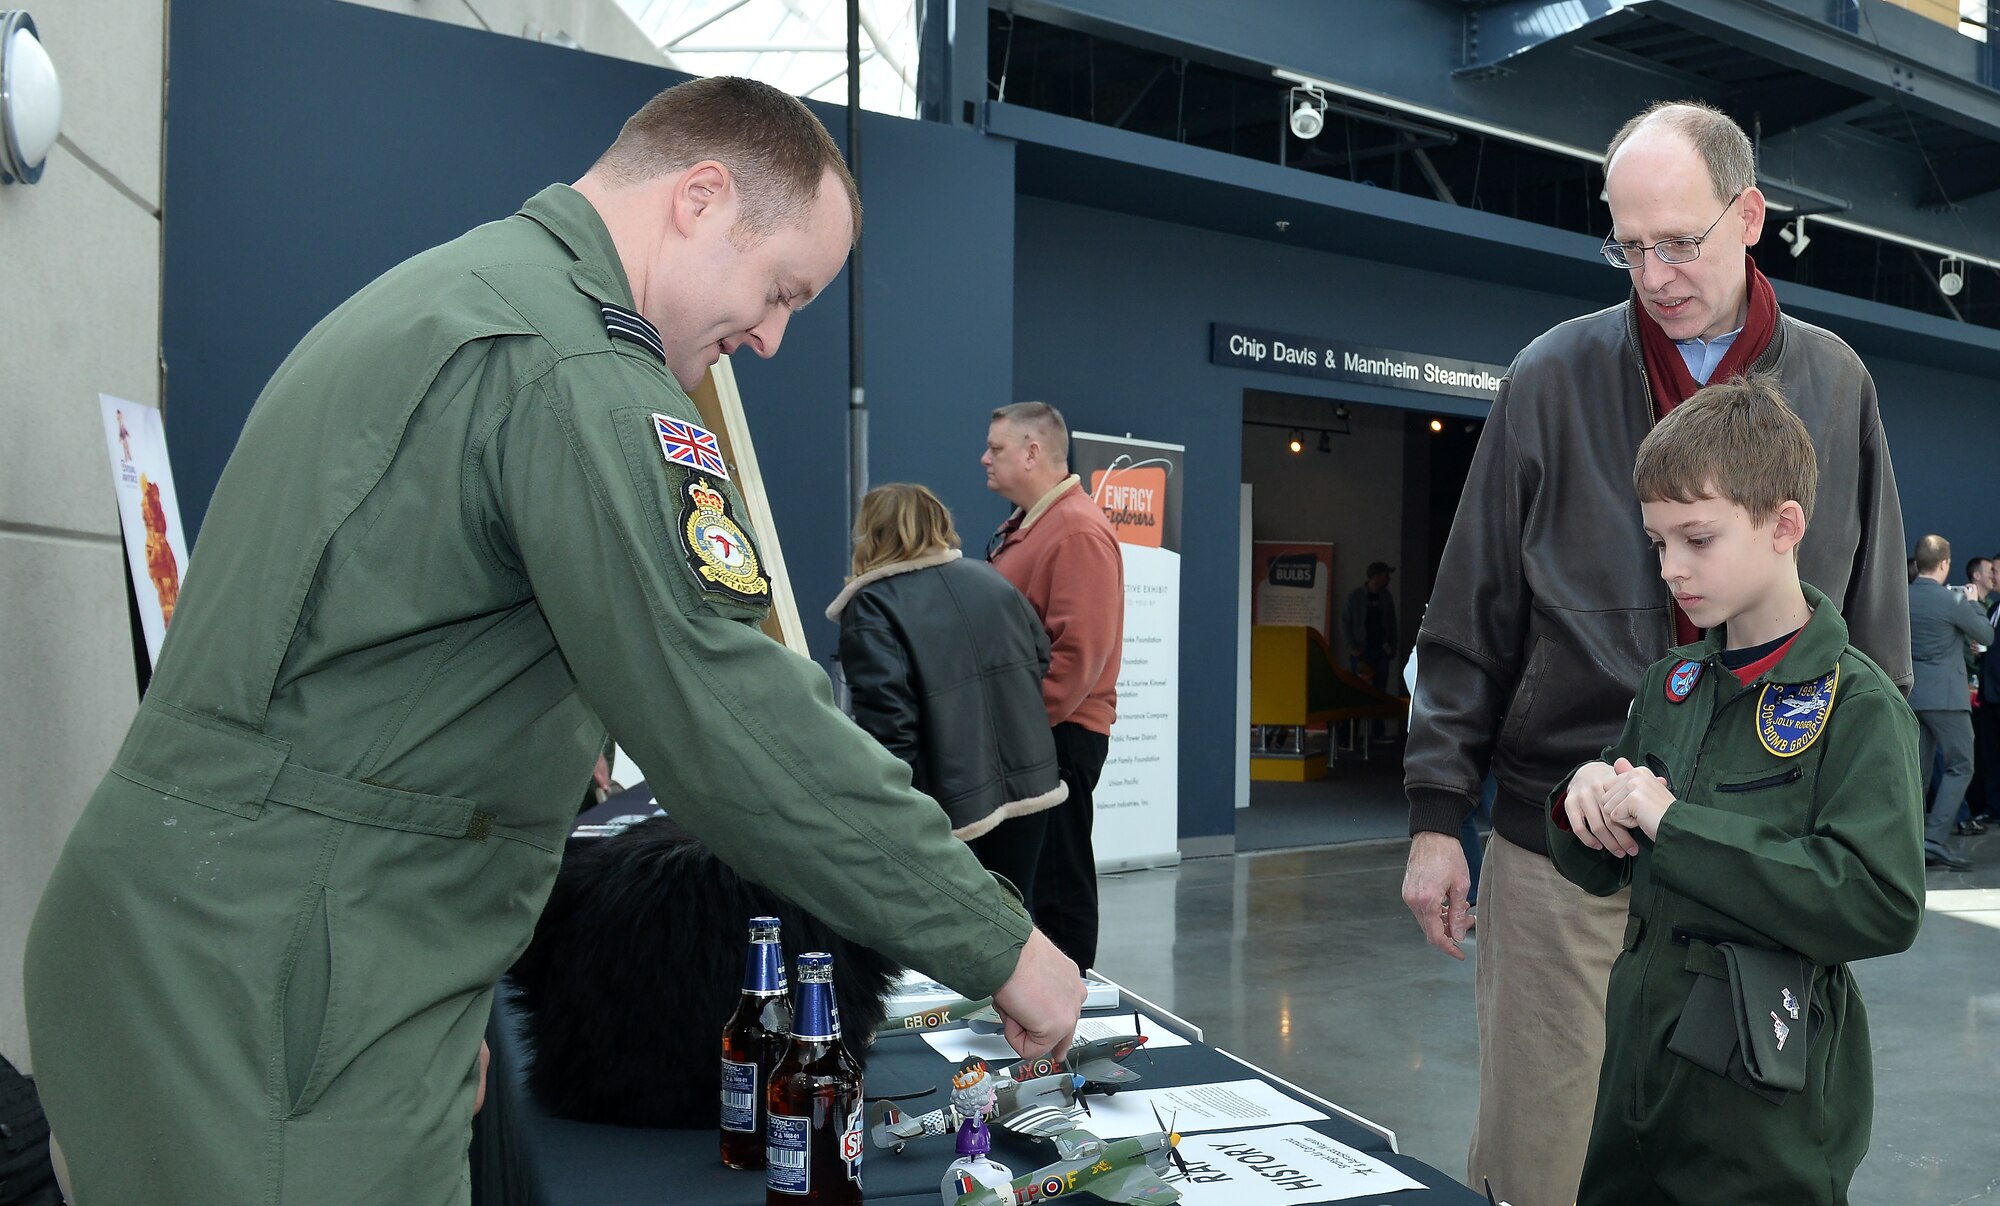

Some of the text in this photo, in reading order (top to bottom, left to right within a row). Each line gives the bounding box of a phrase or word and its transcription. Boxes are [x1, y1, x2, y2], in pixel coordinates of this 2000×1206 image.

[1229, 334, 1500, 391] Chip Davis & Mannheim Steamroller
[1276, 569, 1312, 581] BULBS
[1143, 585, 1168, 594] EXHIBIT
[1136, 635, 1162, 643] Foundation
[1123, 657, 1148, 665] Foundation
[1123, 713, 1145, 721] Insurance
[1147, 712, 1168, 721] Company
[1773, 717, 1795, 728] JOLLY
[1126, 733, 1140, 742] Power
[1763, 725, 1788, 751] BOMB
[1789, 722, 1819, 752] GROUP
[904, 1011, 951, 1029] GB K
[1161, 1138, 1166, 1147] F
[1208, 1143, 1322, 1191] HISTORY
[957, 1170, 963, 1179] F
[1012, 1170, 1079, 1204] TP F
